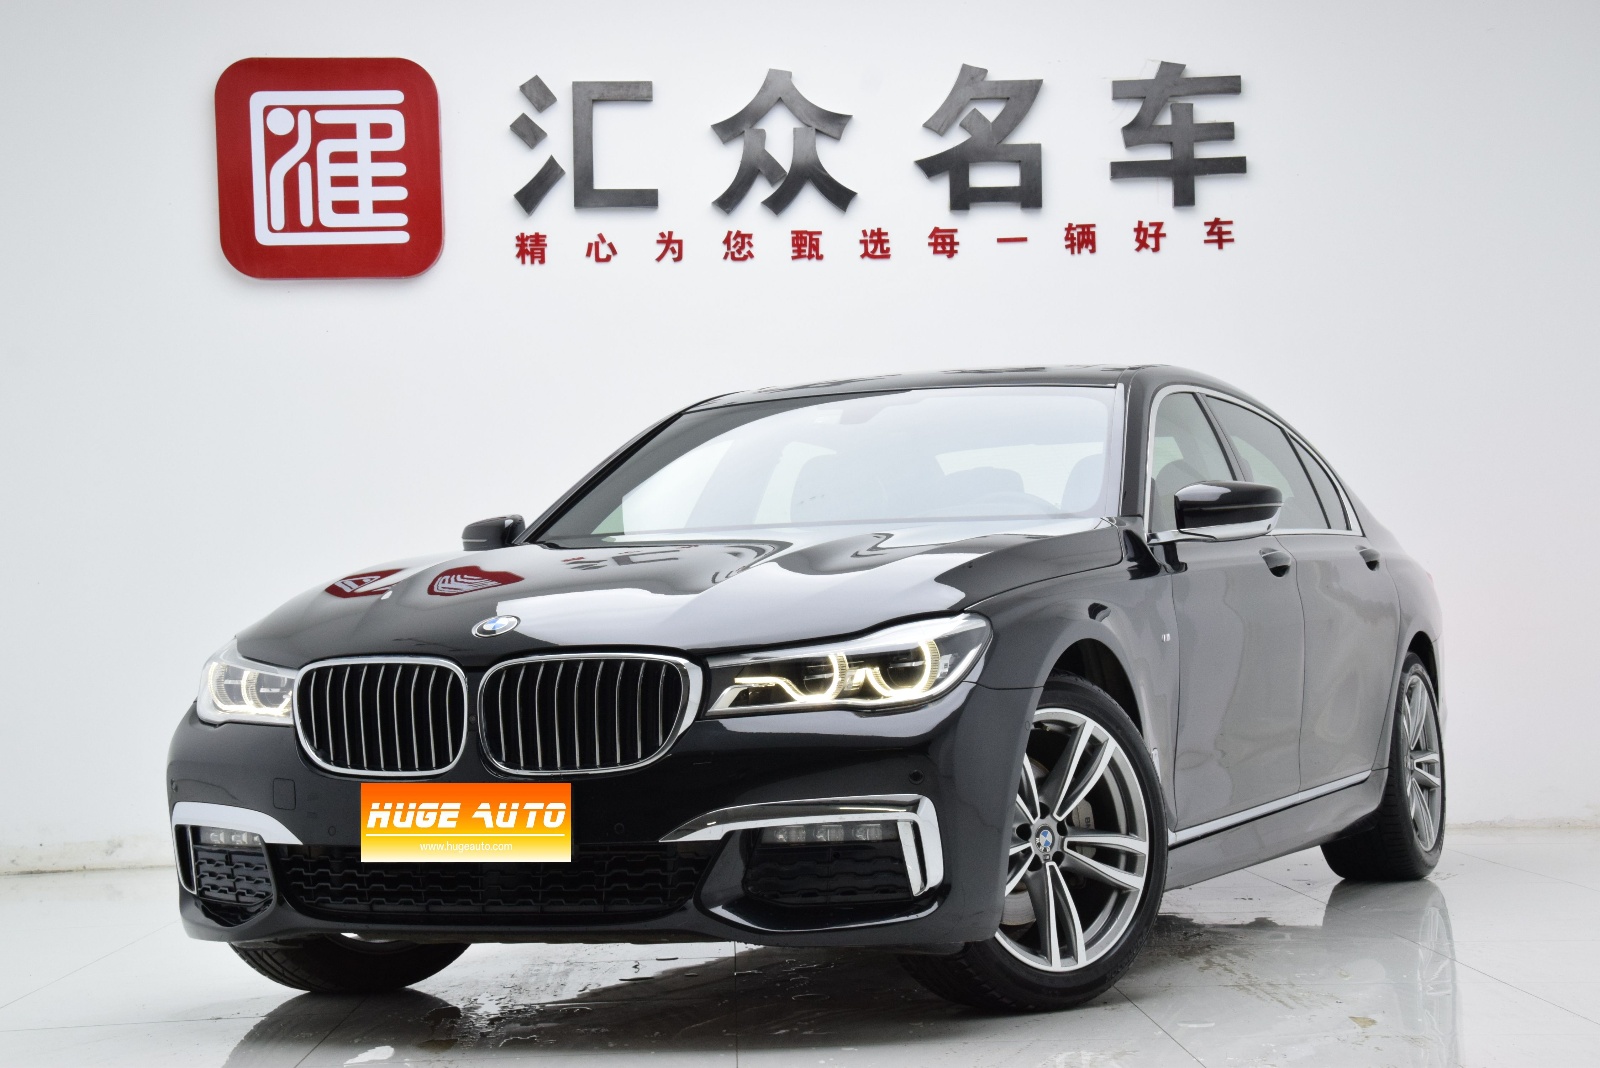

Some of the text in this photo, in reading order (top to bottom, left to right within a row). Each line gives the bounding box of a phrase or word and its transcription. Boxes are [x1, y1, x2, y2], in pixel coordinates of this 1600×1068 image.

[509, 60, 1248, 216] 汇众名车
[515, 217, 1235, 265] 精心为您甄选每一辆好车
